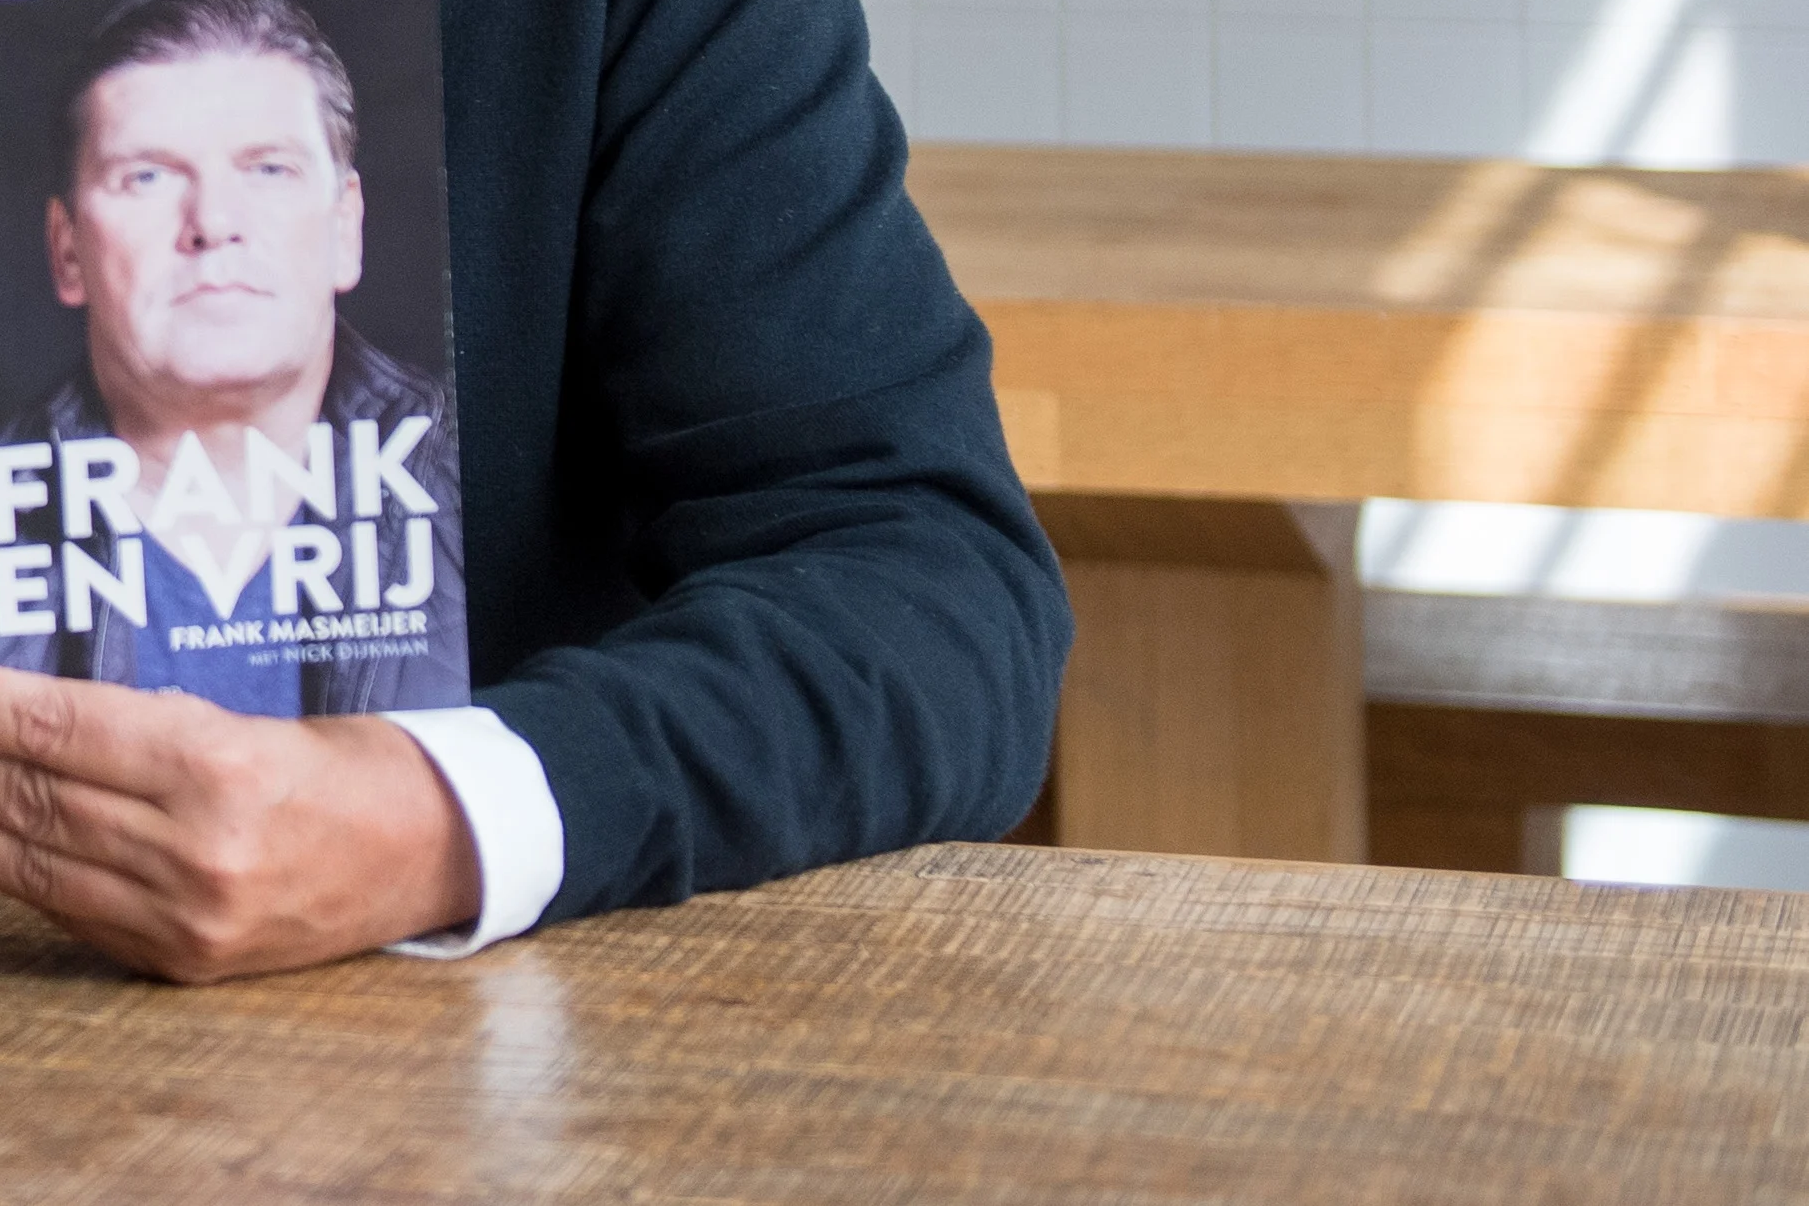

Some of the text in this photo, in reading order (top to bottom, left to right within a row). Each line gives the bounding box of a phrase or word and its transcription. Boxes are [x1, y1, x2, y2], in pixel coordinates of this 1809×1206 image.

[179, 517, 437, 621] VRIJ
[169, 609, 428, 652] FRANK MASMEIJER
[282, 643, 335, 666] NICK
[336, 638, 430, 663] DIJKMAN
